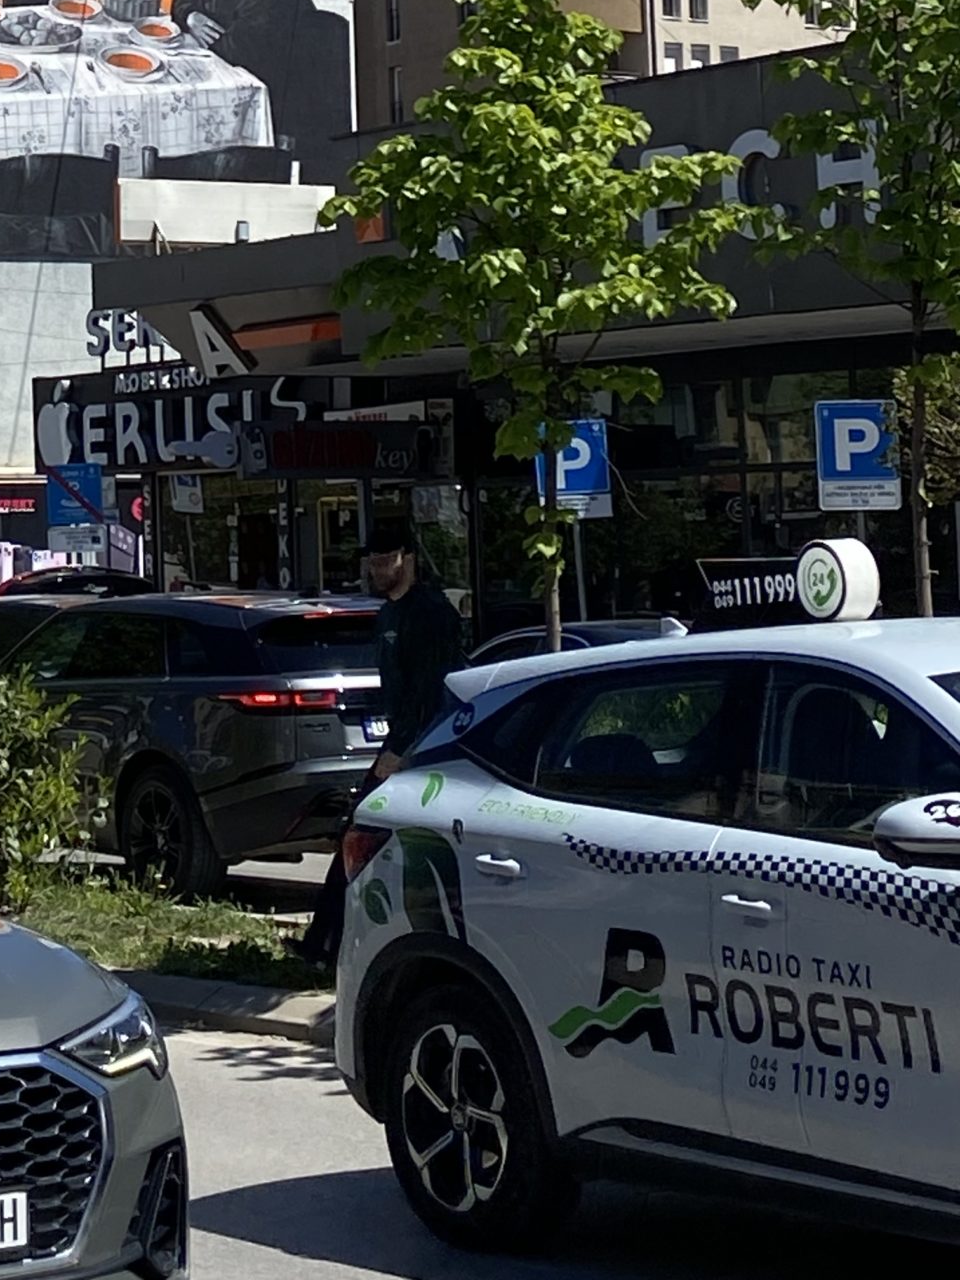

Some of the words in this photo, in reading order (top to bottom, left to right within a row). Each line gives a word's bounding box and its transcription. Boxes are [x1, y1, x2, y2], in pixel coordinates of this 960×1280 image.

[556, 437, 591, 489] P
[834, 419, 880, 471] P
[812, 572, 825, 587] 24
[721, 945, 801, 979] RADIO
[811, 957, 872, 990] TAXI
[685, 972, 941, 1074] ROBERTI
[748, 1072, 777, 1092] 049
[750, 1055, 778, 1072] 044
